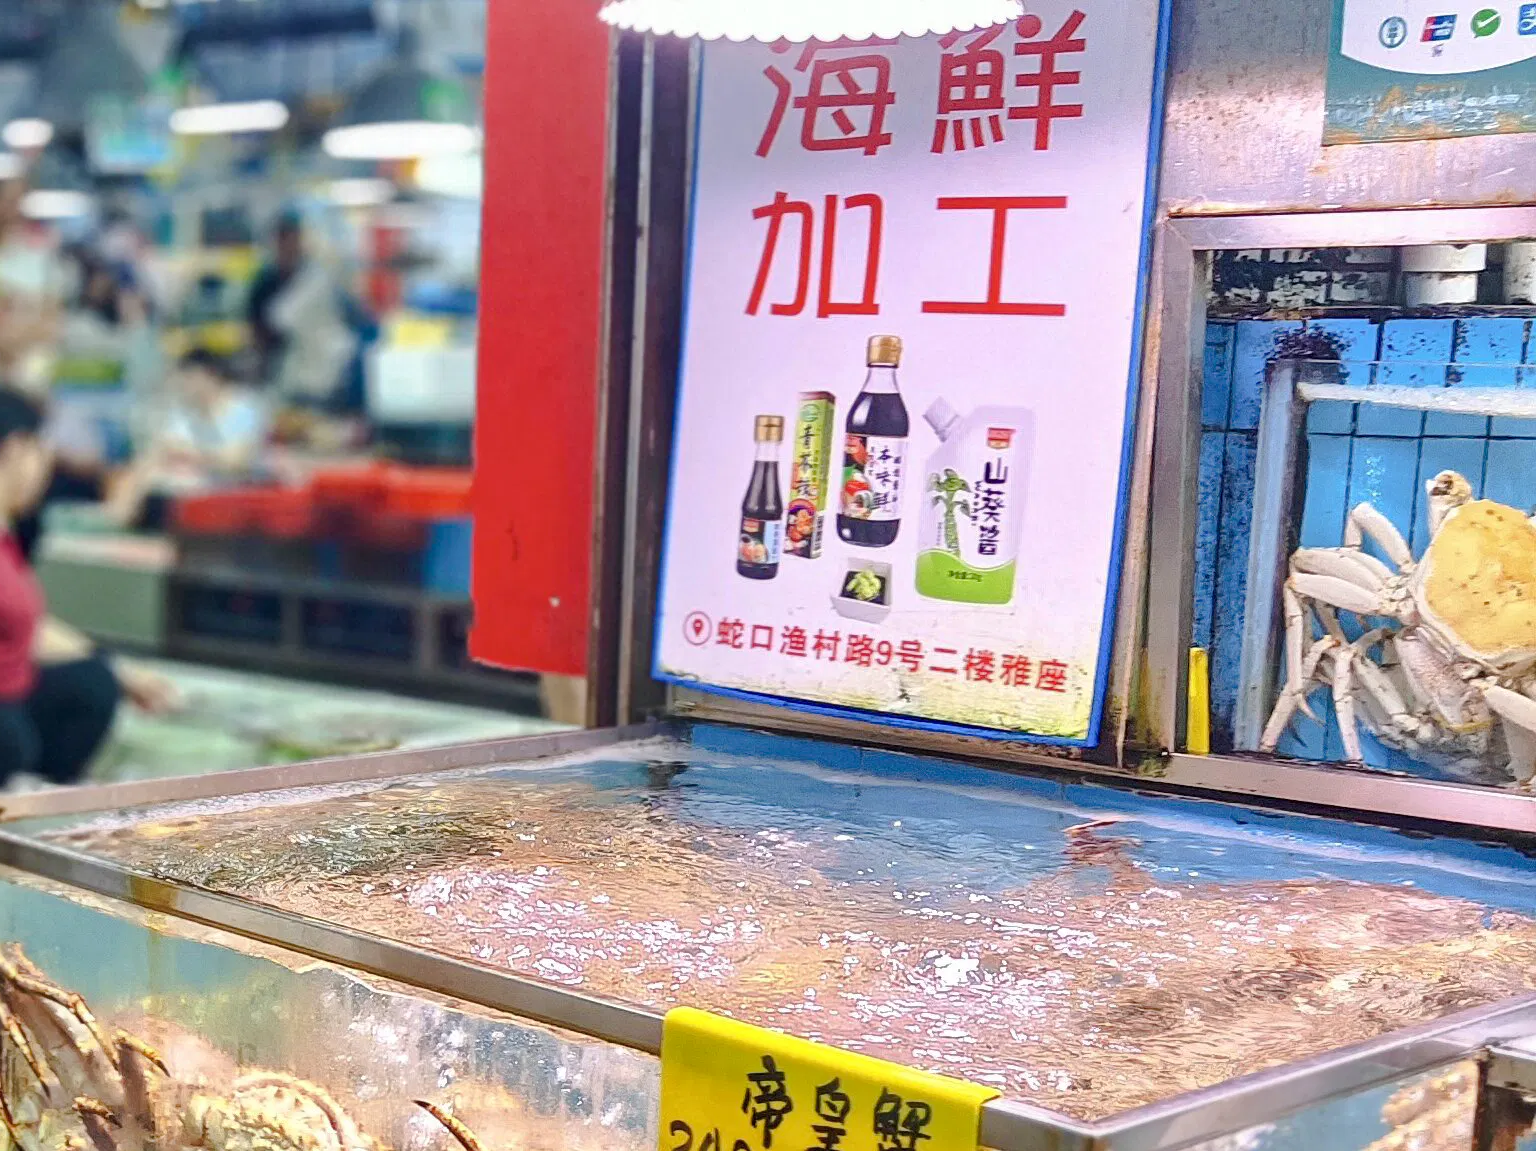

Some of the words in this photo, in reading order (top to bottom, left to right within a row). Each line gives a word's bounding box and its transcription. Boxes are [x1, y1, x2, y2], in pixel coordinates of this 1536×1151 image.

[744, 191, 1067, 318] 加工
[715, 617, 1068, 693] 蛇口渔村路9号二楼雅座
